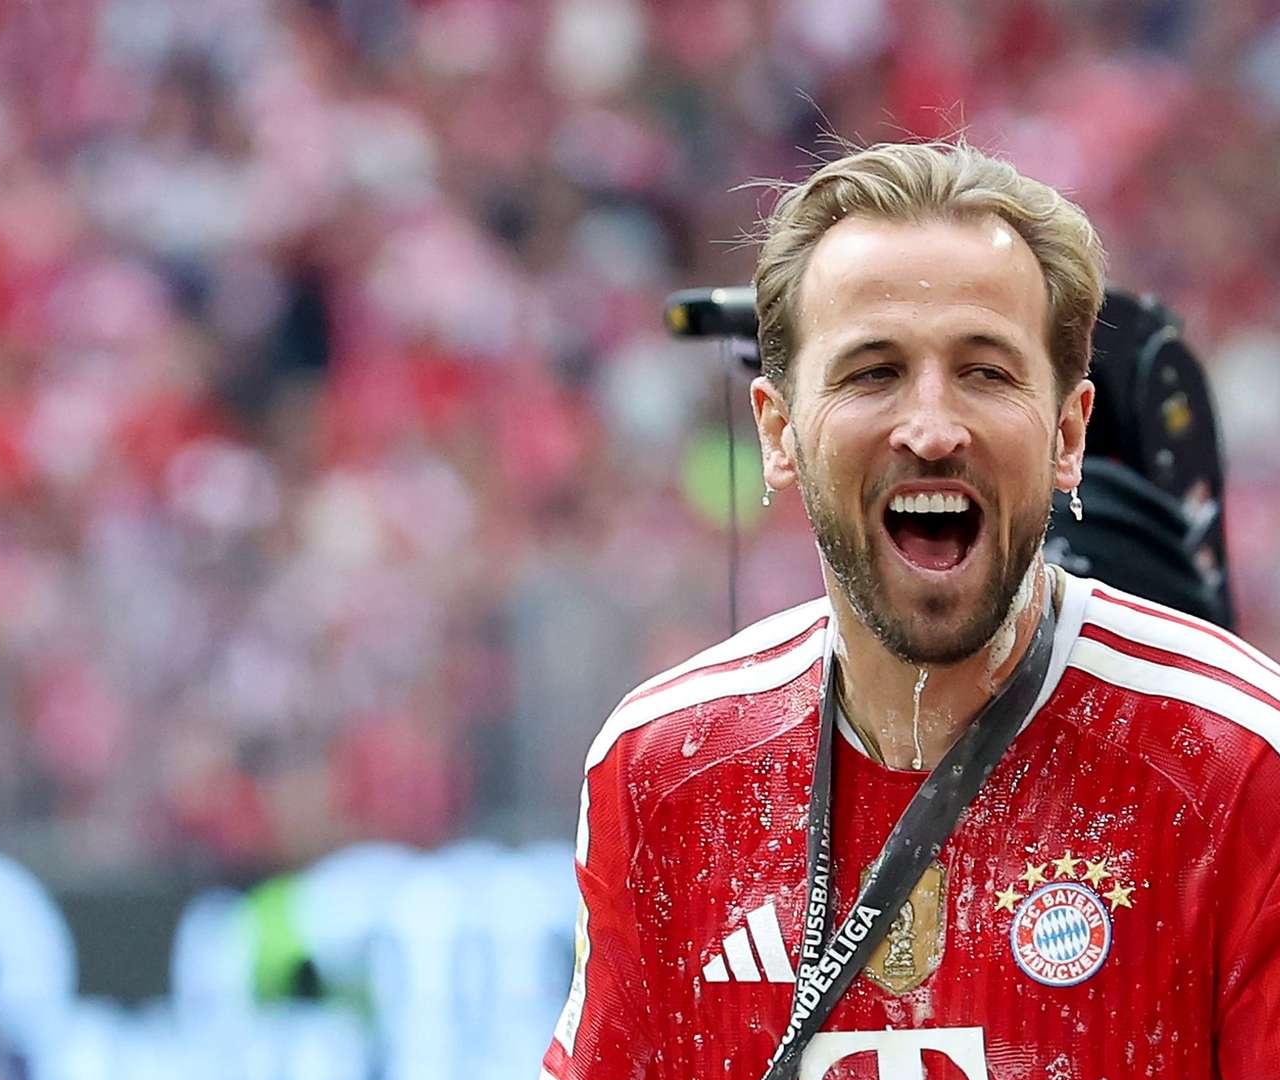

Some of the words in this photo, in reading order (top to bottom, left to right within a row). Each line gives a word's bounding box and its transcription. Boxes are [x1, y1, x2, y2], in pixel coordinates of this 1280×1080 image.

[1021, 904, 1040, 928] FC
[1042, 890, 1102, 928] BAYERN
[772, 905, 882, 1062] UNDESLIGA
